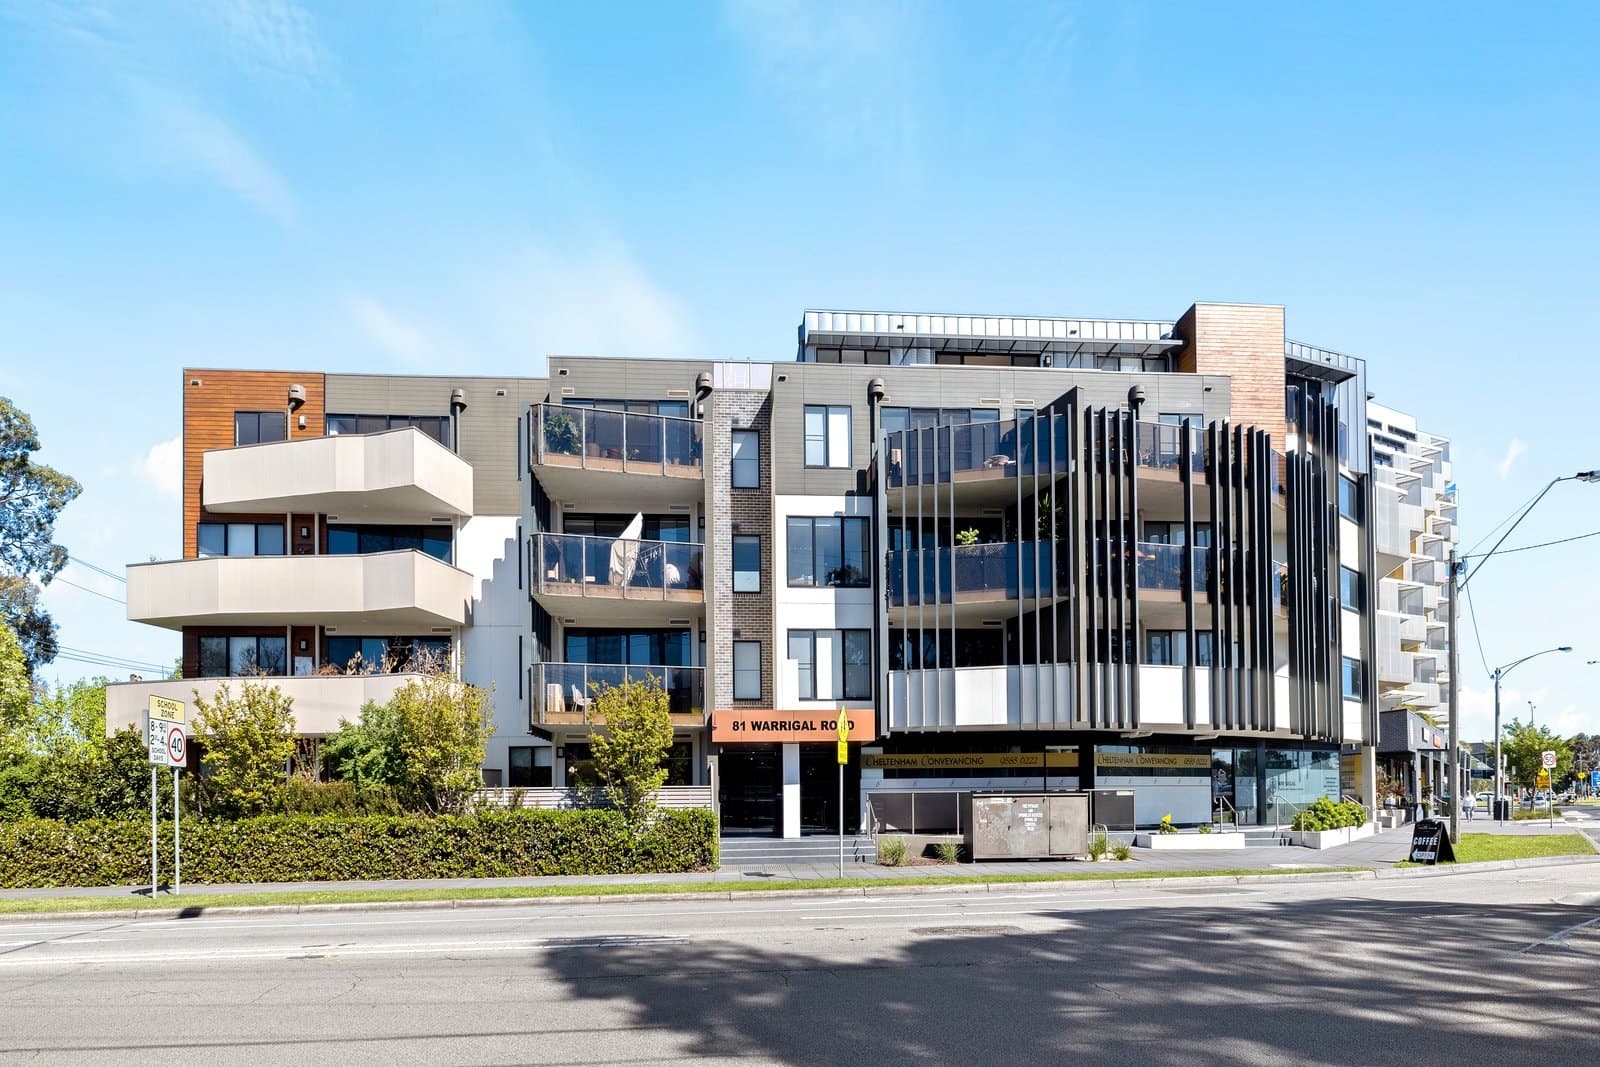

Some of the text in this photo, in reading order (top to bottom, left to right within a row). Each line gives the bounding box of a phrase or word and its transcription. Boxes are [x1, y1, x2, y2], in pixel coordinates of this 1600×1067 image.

[157, 700, 178, 711] SCHOOL
[161, 710, 175, 719] ZONE
[732, 720, 855, 731] 81 WARRIGAL ROD
[171, 737, 183, 752] 40
[1413, 837, 1438, 845] COFFEE
